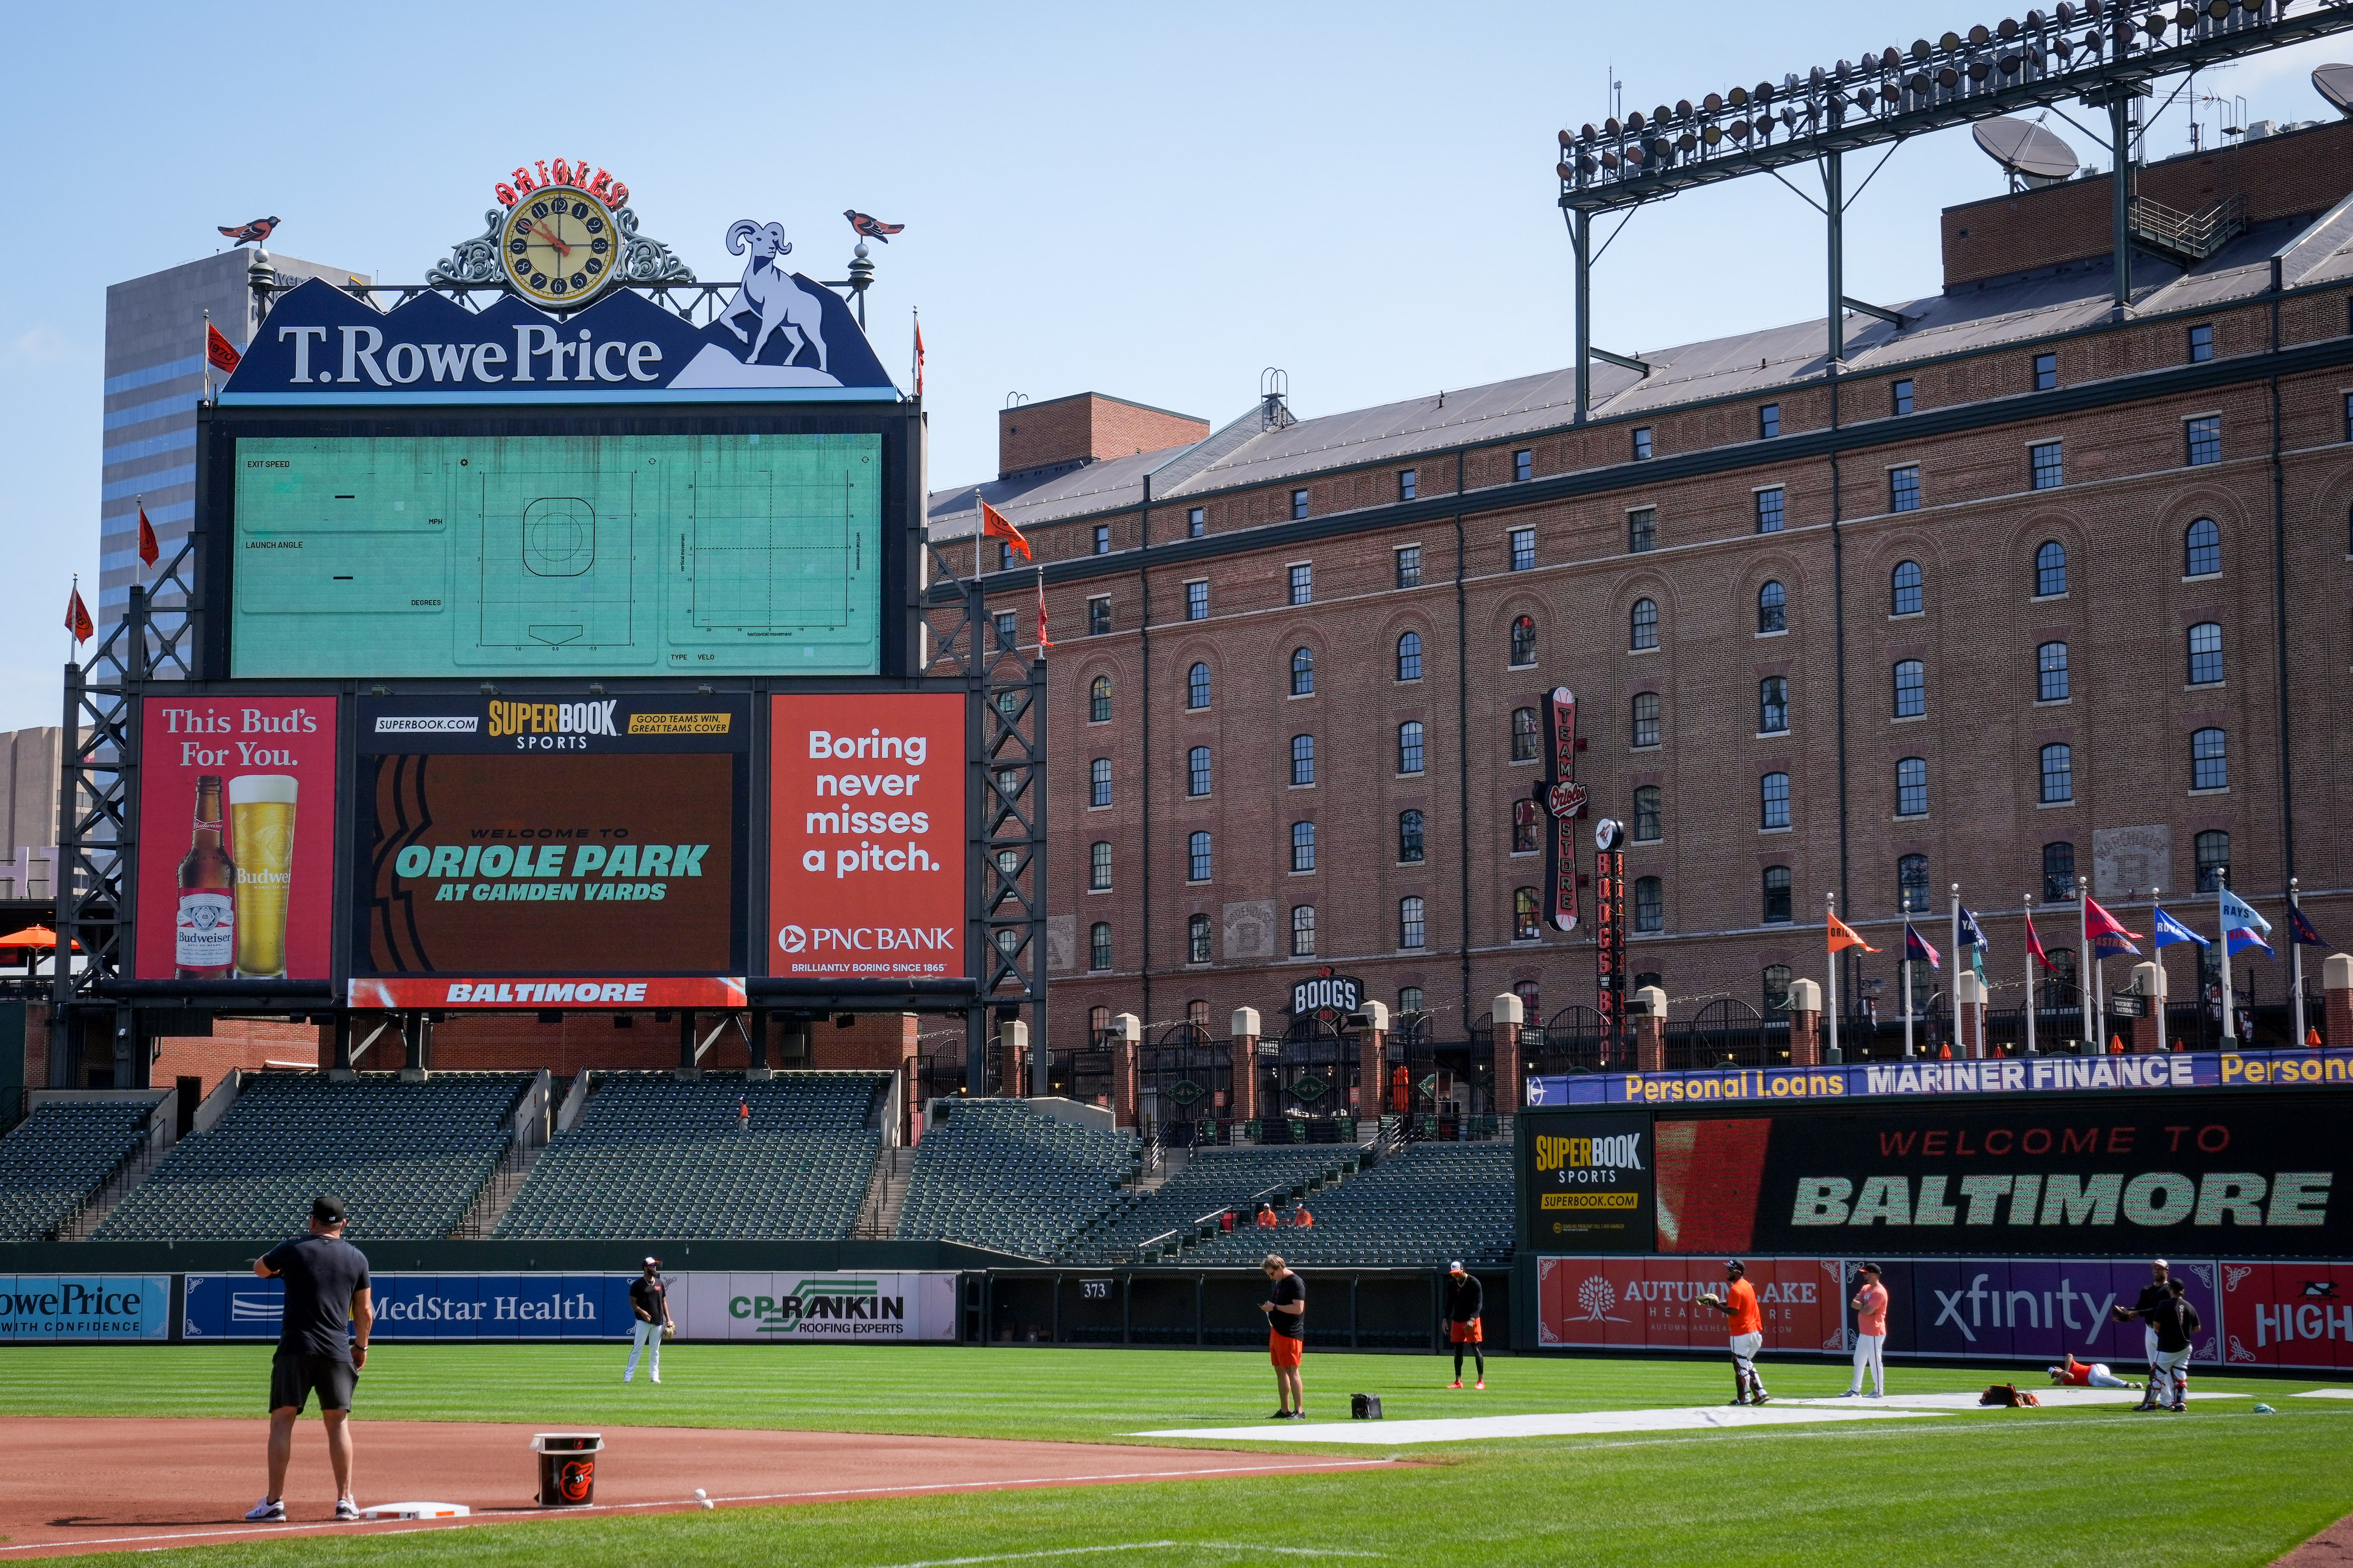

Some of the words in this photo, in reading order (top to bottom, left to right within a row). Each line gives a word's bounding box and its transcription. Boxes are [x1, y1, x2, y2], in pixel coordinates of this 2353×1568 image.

[495, 157, 629, 208] ORIOLES
[533, 205, 547, 218] 11
[554, 200, 566, 213] 12
[576, 205, 583, 218] 1
[588, 220, 600, 231] 2
[512, 241, 524, 251] 9
[593, 241, 606, 250] 3
[517, 262, 529, 272] 8
[589, 261, 599, 272] 4
[533, 274, 545, 286] 7
[554, 280, 563, 293] 6
[575, 276, 584, 287] 5
[209, 342, 233, 361] 1970
[512, 324, 663, 383] Price
[162, 708, 231, 733] This
[240, 708, 317, 733] Bud's
[379, 720, 475, 730] SUPERBOOK.COM
[489, 700, 617, 737] SUPERBOOK
[637, 715, 666, 723] GOOD
[668, 715, 698, 723] TEAMS
[700, 715, 721, 724] WIN,
[631, 724, 662, 732] GREAT
[663, 724, 692, 732] TEAMS
[694, 723, 727, 732] COVER
[516, 736, 587, 749] SPORTS
[809, 728, 926, 766] Boring
[1559, 708, 1571, 777] TEAM
[180, 741, 229, 766] For
[235, 741, 298, 766] You.
[816, 774, 920, 796] never
[1550, 784, 1586, 809] Orioles
[806, 803, 929, 834] misses
[470, 829, 590, 839] WELCOME
[600, 829, 630, 838] TO
[395, 844, 570, 878] ORIOLE
[571, 844, 710, 877] PARK
[803, 850, 825, 872] a
[837, 841, 940, 878] pitch.
[1561, 822, 1573, 909] STORE
[435, 884, 469, 901] AT
[472, 883, 583, 901] CAMDEN
[584, 883, 667, 900] YARDS
[2223, 905, 2249, 919] RAYS
[179, 932, 231, 943] Budweiser
[792, 964, 850, 972] BRILLIANTLY
[852, 963, 890, 972] BORING
[892, 963, 921, 971] SINCE
[446, 982, 648, 1003] BALTIMORE
[1295, 979, 1356, 1014] BOOG'S
[1319, 1010, 1333, 1020] BBQ
[1625, 1070, 1748, 1101] Personal
[1757, 1070, 1844, 1097] Loans
[1866, 1061, 2024, 1094] MARINER
[2032, 1055, 2193, 1089] FINANCE
[1879, 1126, 2136, 1157] WELCOME
[2165, 1124, 2230, 1152] TO
[1536, 1132, 1641, 1171] SUPERBOOK
[1558, 1170, 1616, 1184] SPORTS
[1544, 1196, 1634, 1206] SUPERBOOK.COM
[1790, 1172, 2333, 1226] BALTIMORE
[1084, 1283, 1106, 1297] 373
[60, 1284, 140, 1315] Price
[494, 1292, 597, 1321] Health
[730, 1296, 775, 1318] CP
[782, 1296, 904, 1319] RANKIN
[1934, 1274, 2116, 1345] xfinity
[2, 1322, 38, 1332] WITH
[44, 1322, 140, 1332] CONFIDENCE
[799, 1323, 850, 1333] ROOFING
[853, 1324, 904, 1333] EXPERTS
